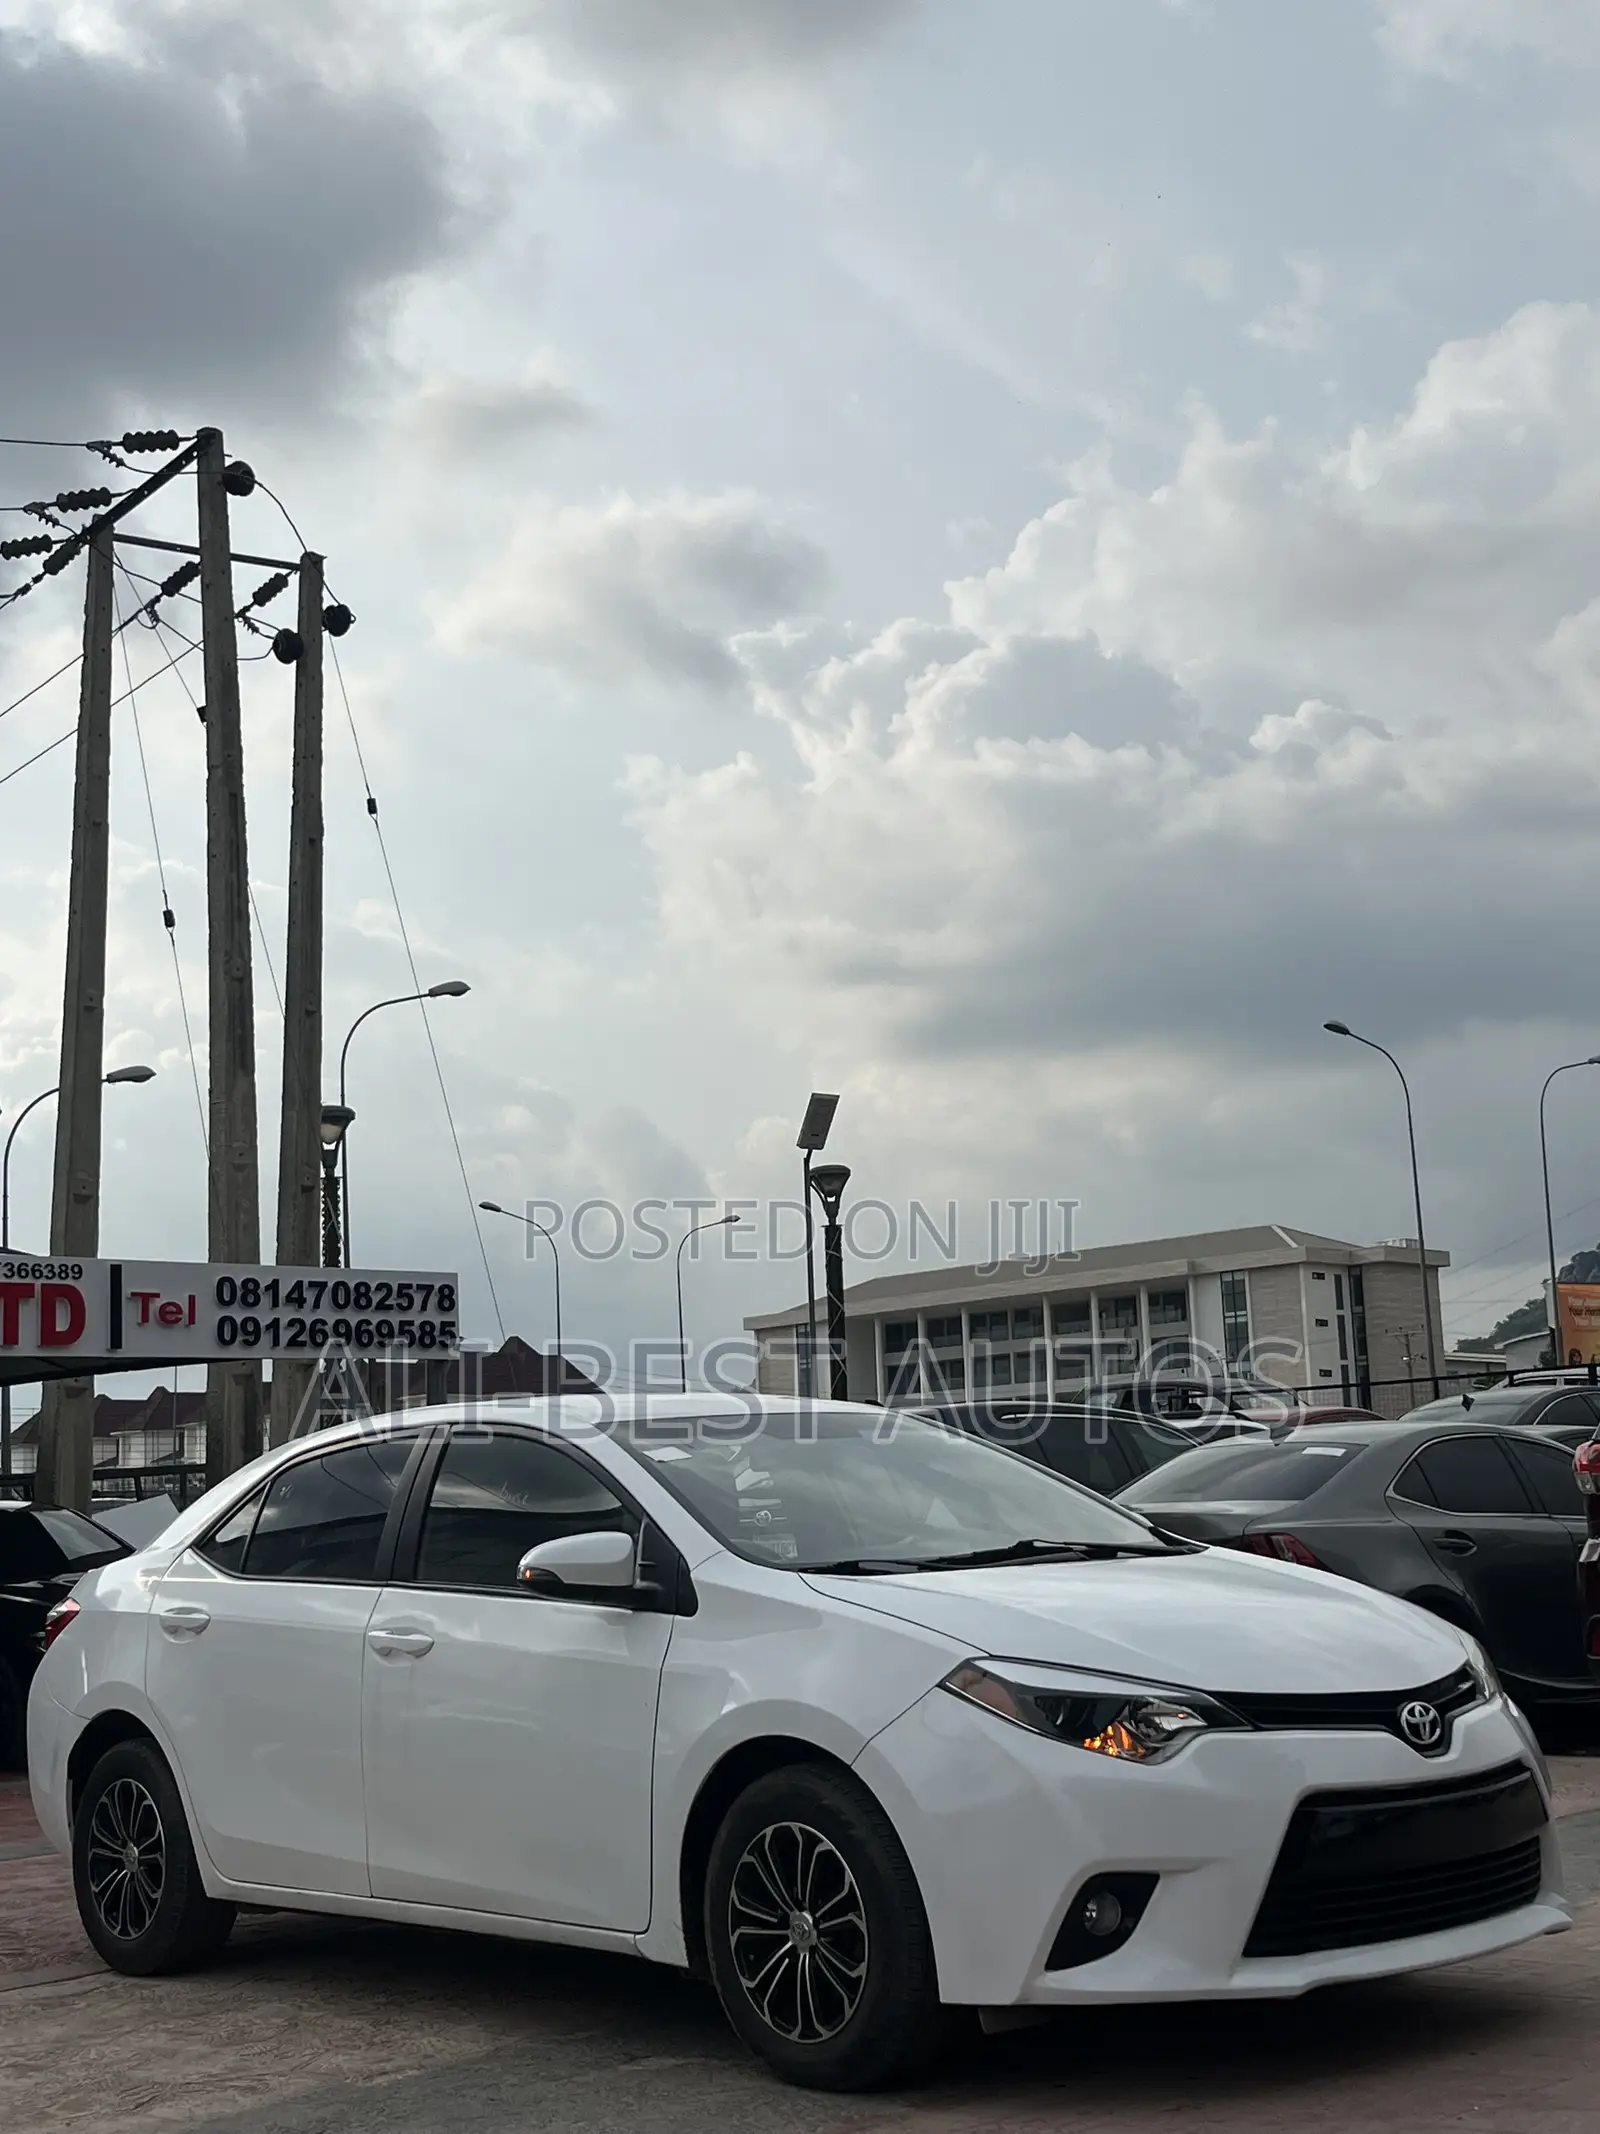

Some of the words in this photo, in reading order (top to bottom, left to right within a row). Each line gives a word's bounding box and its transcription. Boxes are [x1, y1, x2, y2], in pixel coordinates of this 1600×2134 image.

[0, 1262, 83, 1280] 366389
[130, 1291, 196, 1326] Tel
[215, 1276, 456, 1312] 08147082578
[216, 1314, 457, 1348] 09126969585
